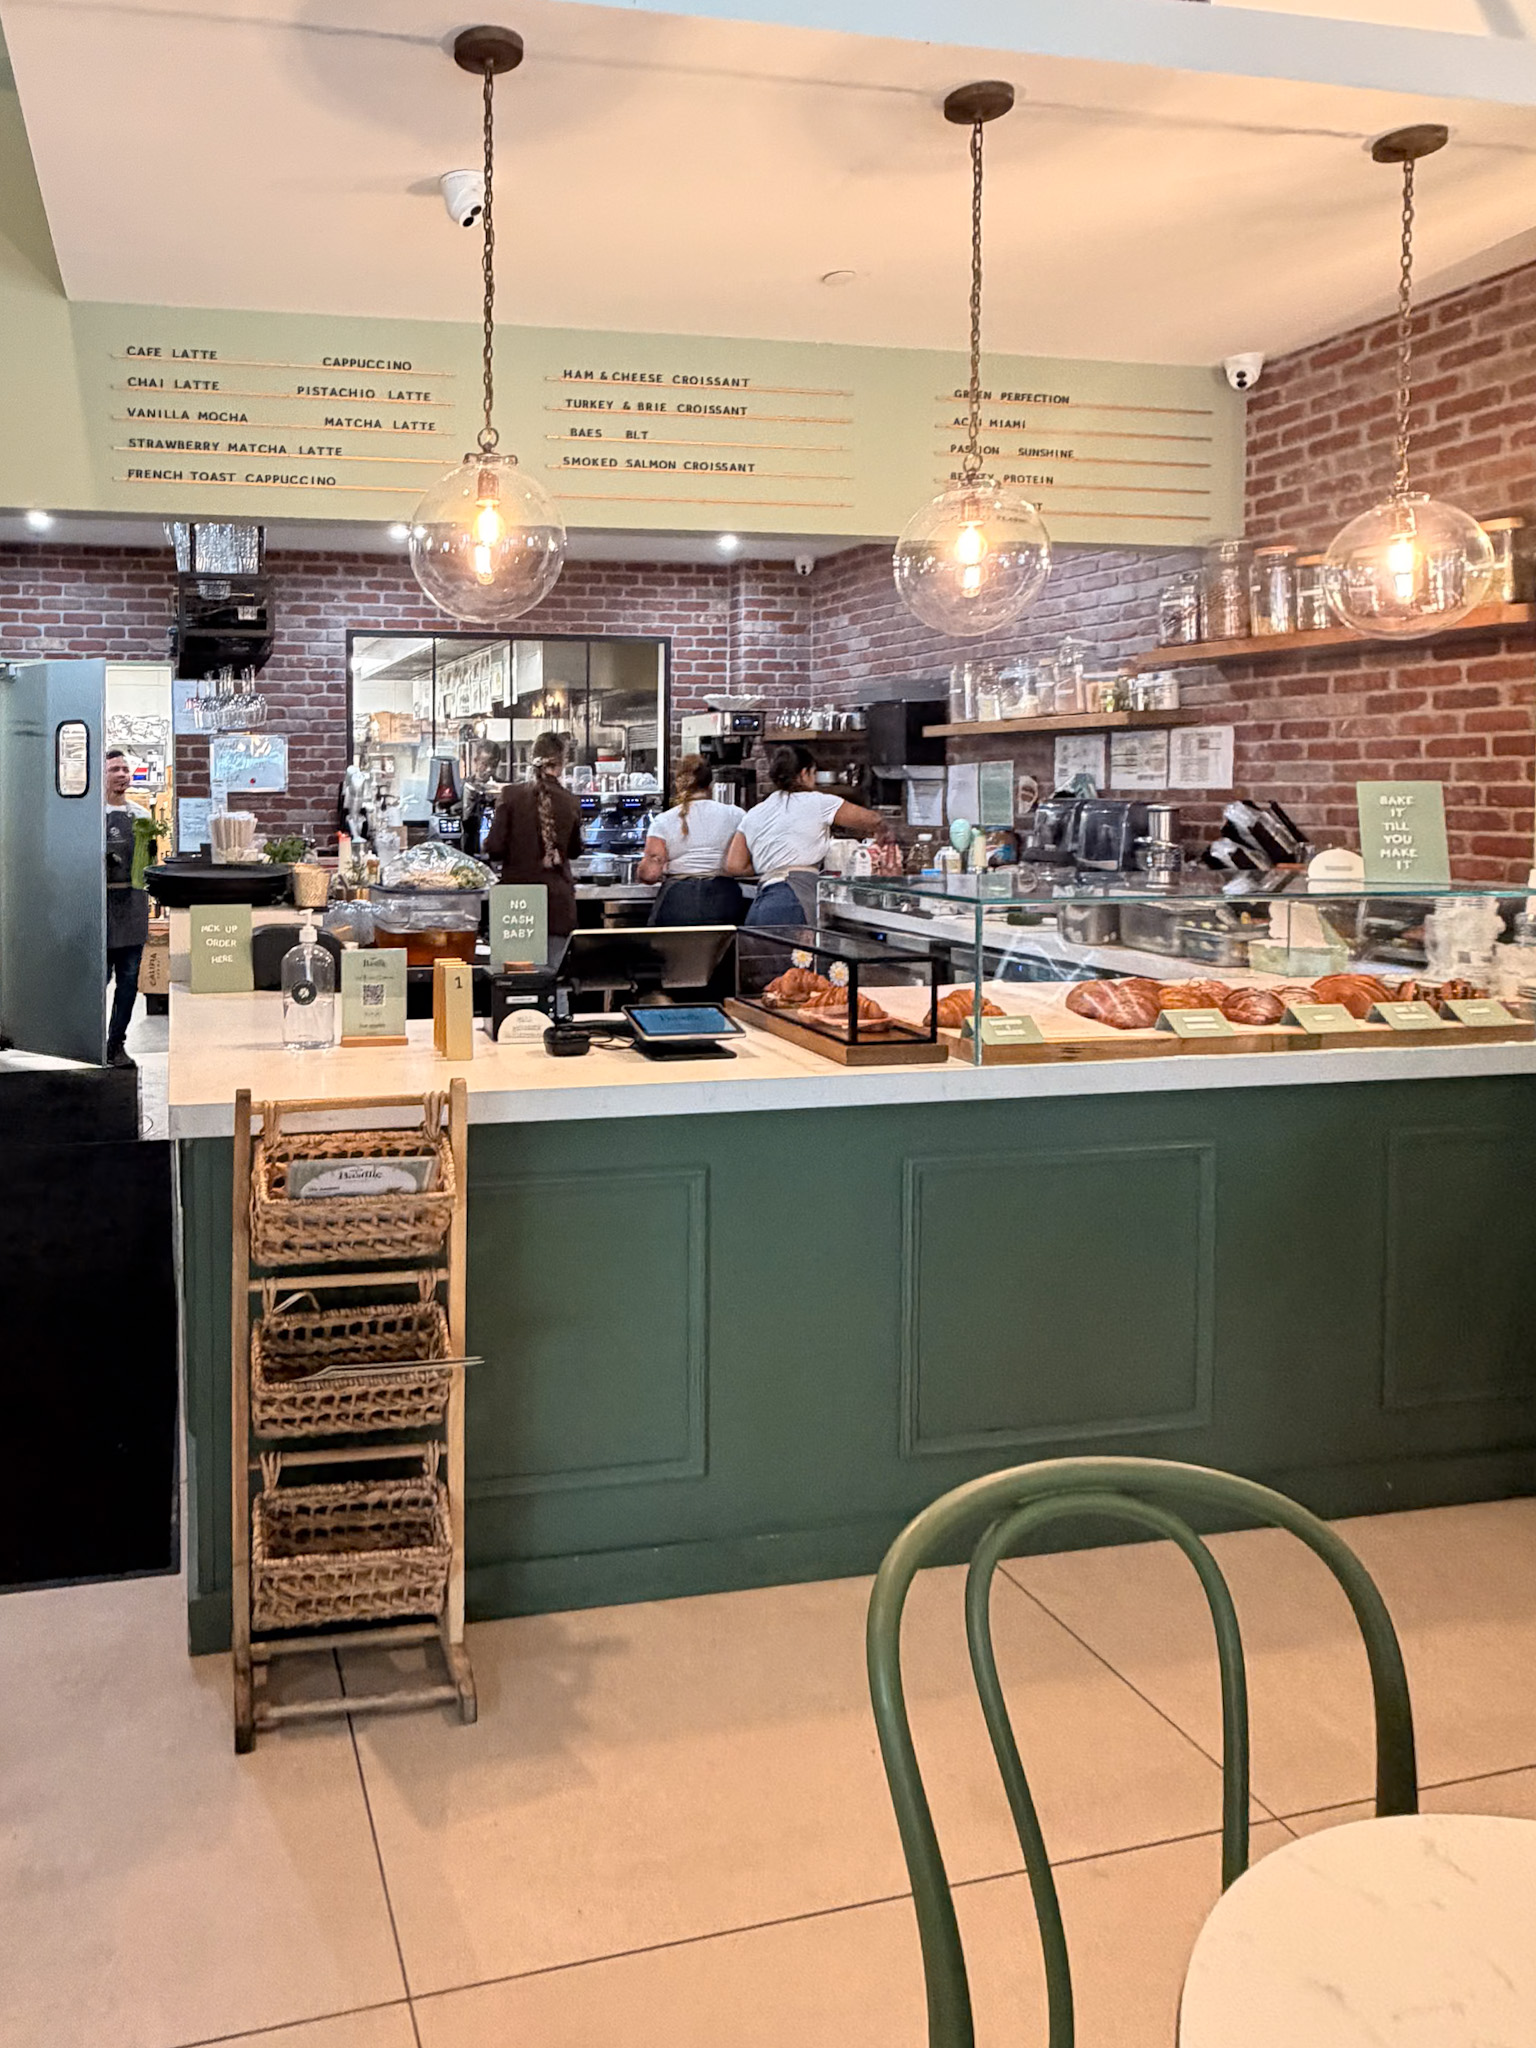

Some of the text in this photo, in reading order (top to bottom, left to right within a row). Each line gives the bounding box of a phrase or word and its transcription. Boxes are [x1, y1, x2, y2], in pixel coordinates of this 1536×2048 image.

[126, 345, 218, 361] CAFE LATTE
[322, 356, 413, 371] CAPPUCCINO
[127, 376, 220, 391] CHAI LATTE
[563, 369, 751, 388] HAM & CHEESE CROISSANT
[296, 385, 431, 402] PISTACHIO LATTE
[954, 388, 1070, 405] GREN PERFECTION
[565, 398, 749, 416] TURKEY & BRIE CROISSANT
[126, 407, 249, 423] VANILLA MOCHA
[324, 416, 436, 432] MATCHA LATTE
[953, 417, 1026, 430] ACI MIAMI
[569, 427, 649, 440] BAES BLT
[128, 437, 343, 457] STRAWBERRY MATCHA LATTE
[950, 443, 1075, 459] PASION SUNSHINE
[562, 456, 756, 473] SMOKED SALMON CROISSANT
[127, 468, 337, 486] FRENCH TOAST CAPPUCCINO
[1002, 473, 1054, 485] PROTEIN
[1379, 795, 1414, 806] BAKE
[1390, 807, 1406, 818] IT
[1382, 821, 1410, 832] TILL
[1383, 834, 1412, 845] YOU
[1380, 848, 1418, 859] MAKE
[1396, 860, 1412, 870] IT
[510, 899, 527, 910] NO
[502, 914, 535, 925] CASH
[224, 925, 238, 934] UP
[503, 928, 534, 940] BABY
[205, 938, 237, 948] ORDER
[211, 954, 233, 964] HERE
[454, 975, 463, 989] 1
